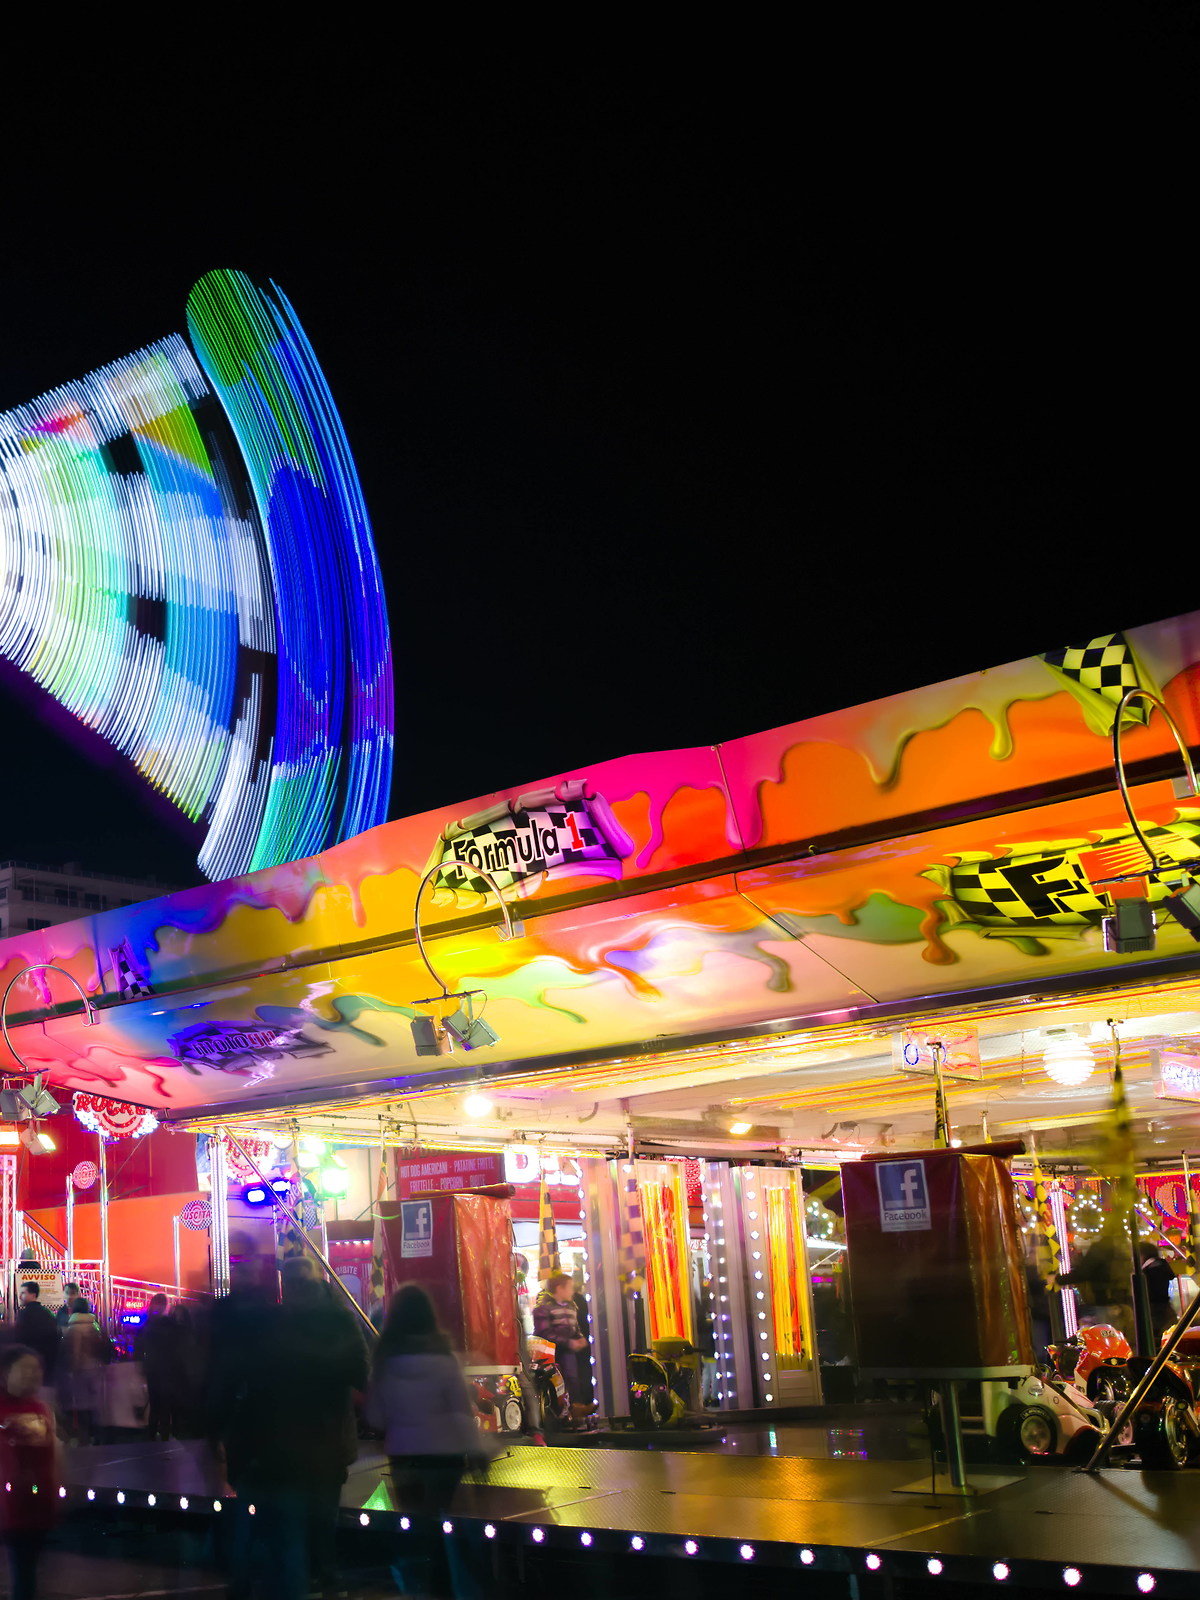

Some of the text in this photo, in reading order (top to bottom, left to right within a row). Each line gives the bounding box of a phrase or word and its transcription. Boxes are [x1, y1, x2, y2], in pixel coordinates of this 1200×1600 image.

[452, 811, 585, 879] Formula 1
[410, 1165, 421, 1177] DOG
[421, 1161, 448, 1176] AMERICANI
[453, 1159, 477, 1173] PATATINE
[477, 1156, 494, 1171] FRITTE
[409, 1179, 434, 1192] FRITTELLE
[440, 1176, 463, 1189] POPCORN
[883, 1209, 928, 1221] Facebook
[402, 1240, 431, 1249] Facebook
